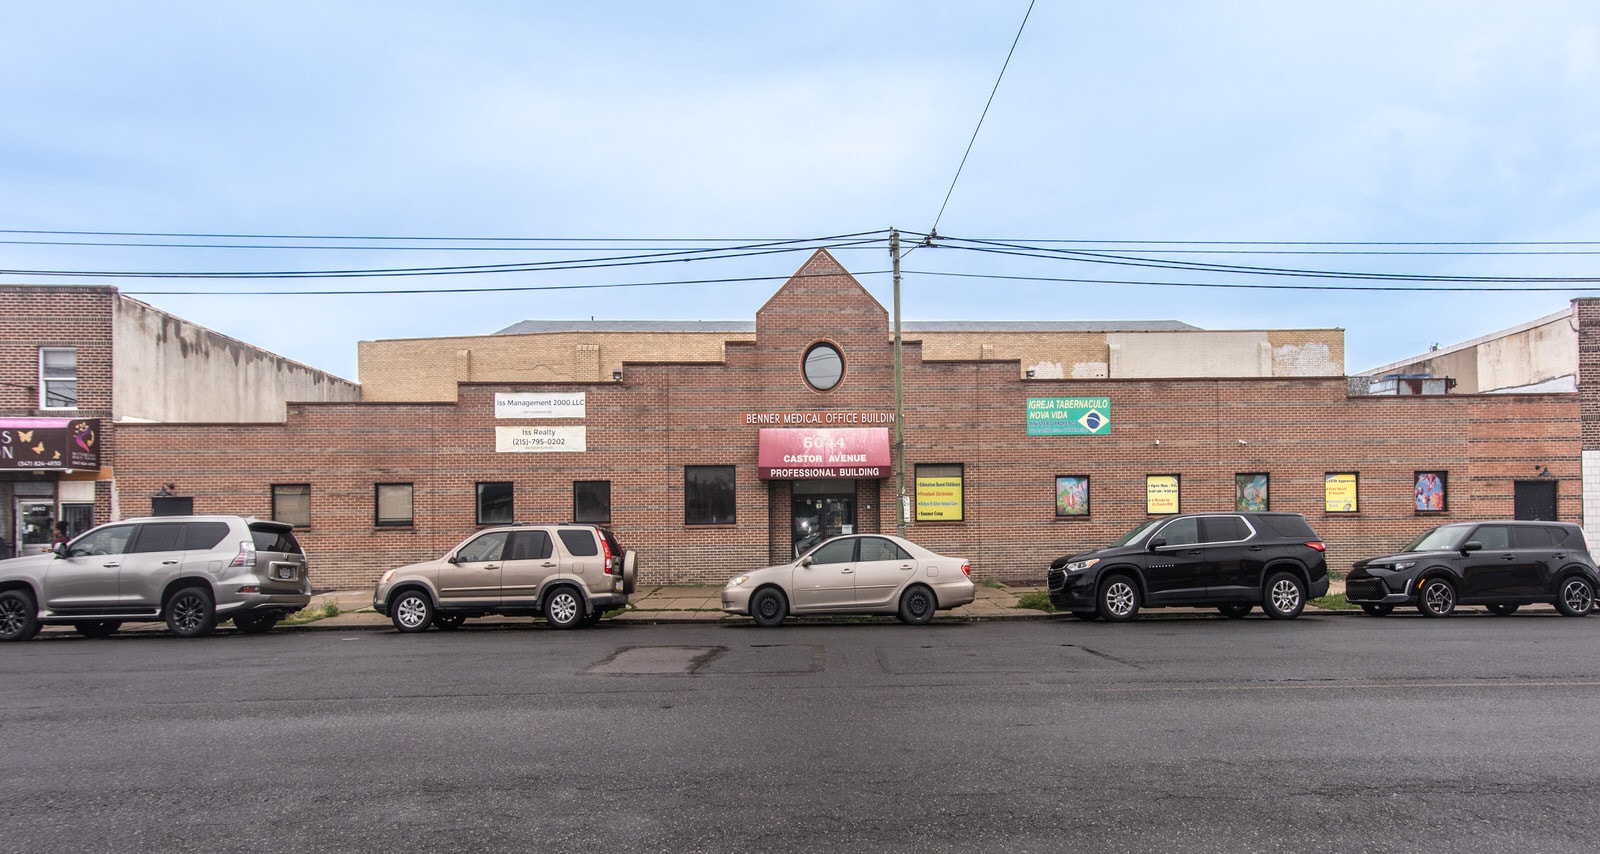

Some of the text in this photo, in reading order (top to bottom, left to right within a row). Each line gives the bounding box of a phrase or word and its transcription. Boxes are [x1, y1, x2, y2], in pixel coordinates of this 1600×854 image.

[507, 399, 552, 407] Management
[1028, 399, 1108, 409] IGREJA TABERNACULO
[746, 412, 903, 424] BENNER MEDICAL OFFICE BUILDIN
[1029, 411, 1068, 419] NOVA VIDA
[533, 429, 556, 437] Realty
[512, 438, 566, 446] (215)-795-0202
[0, 446, 13, 459] N
[783, 454, 867, 463] CASTOR AVENUE
[770, 467, 880, 477] PROFESSIONAL BUILDING
